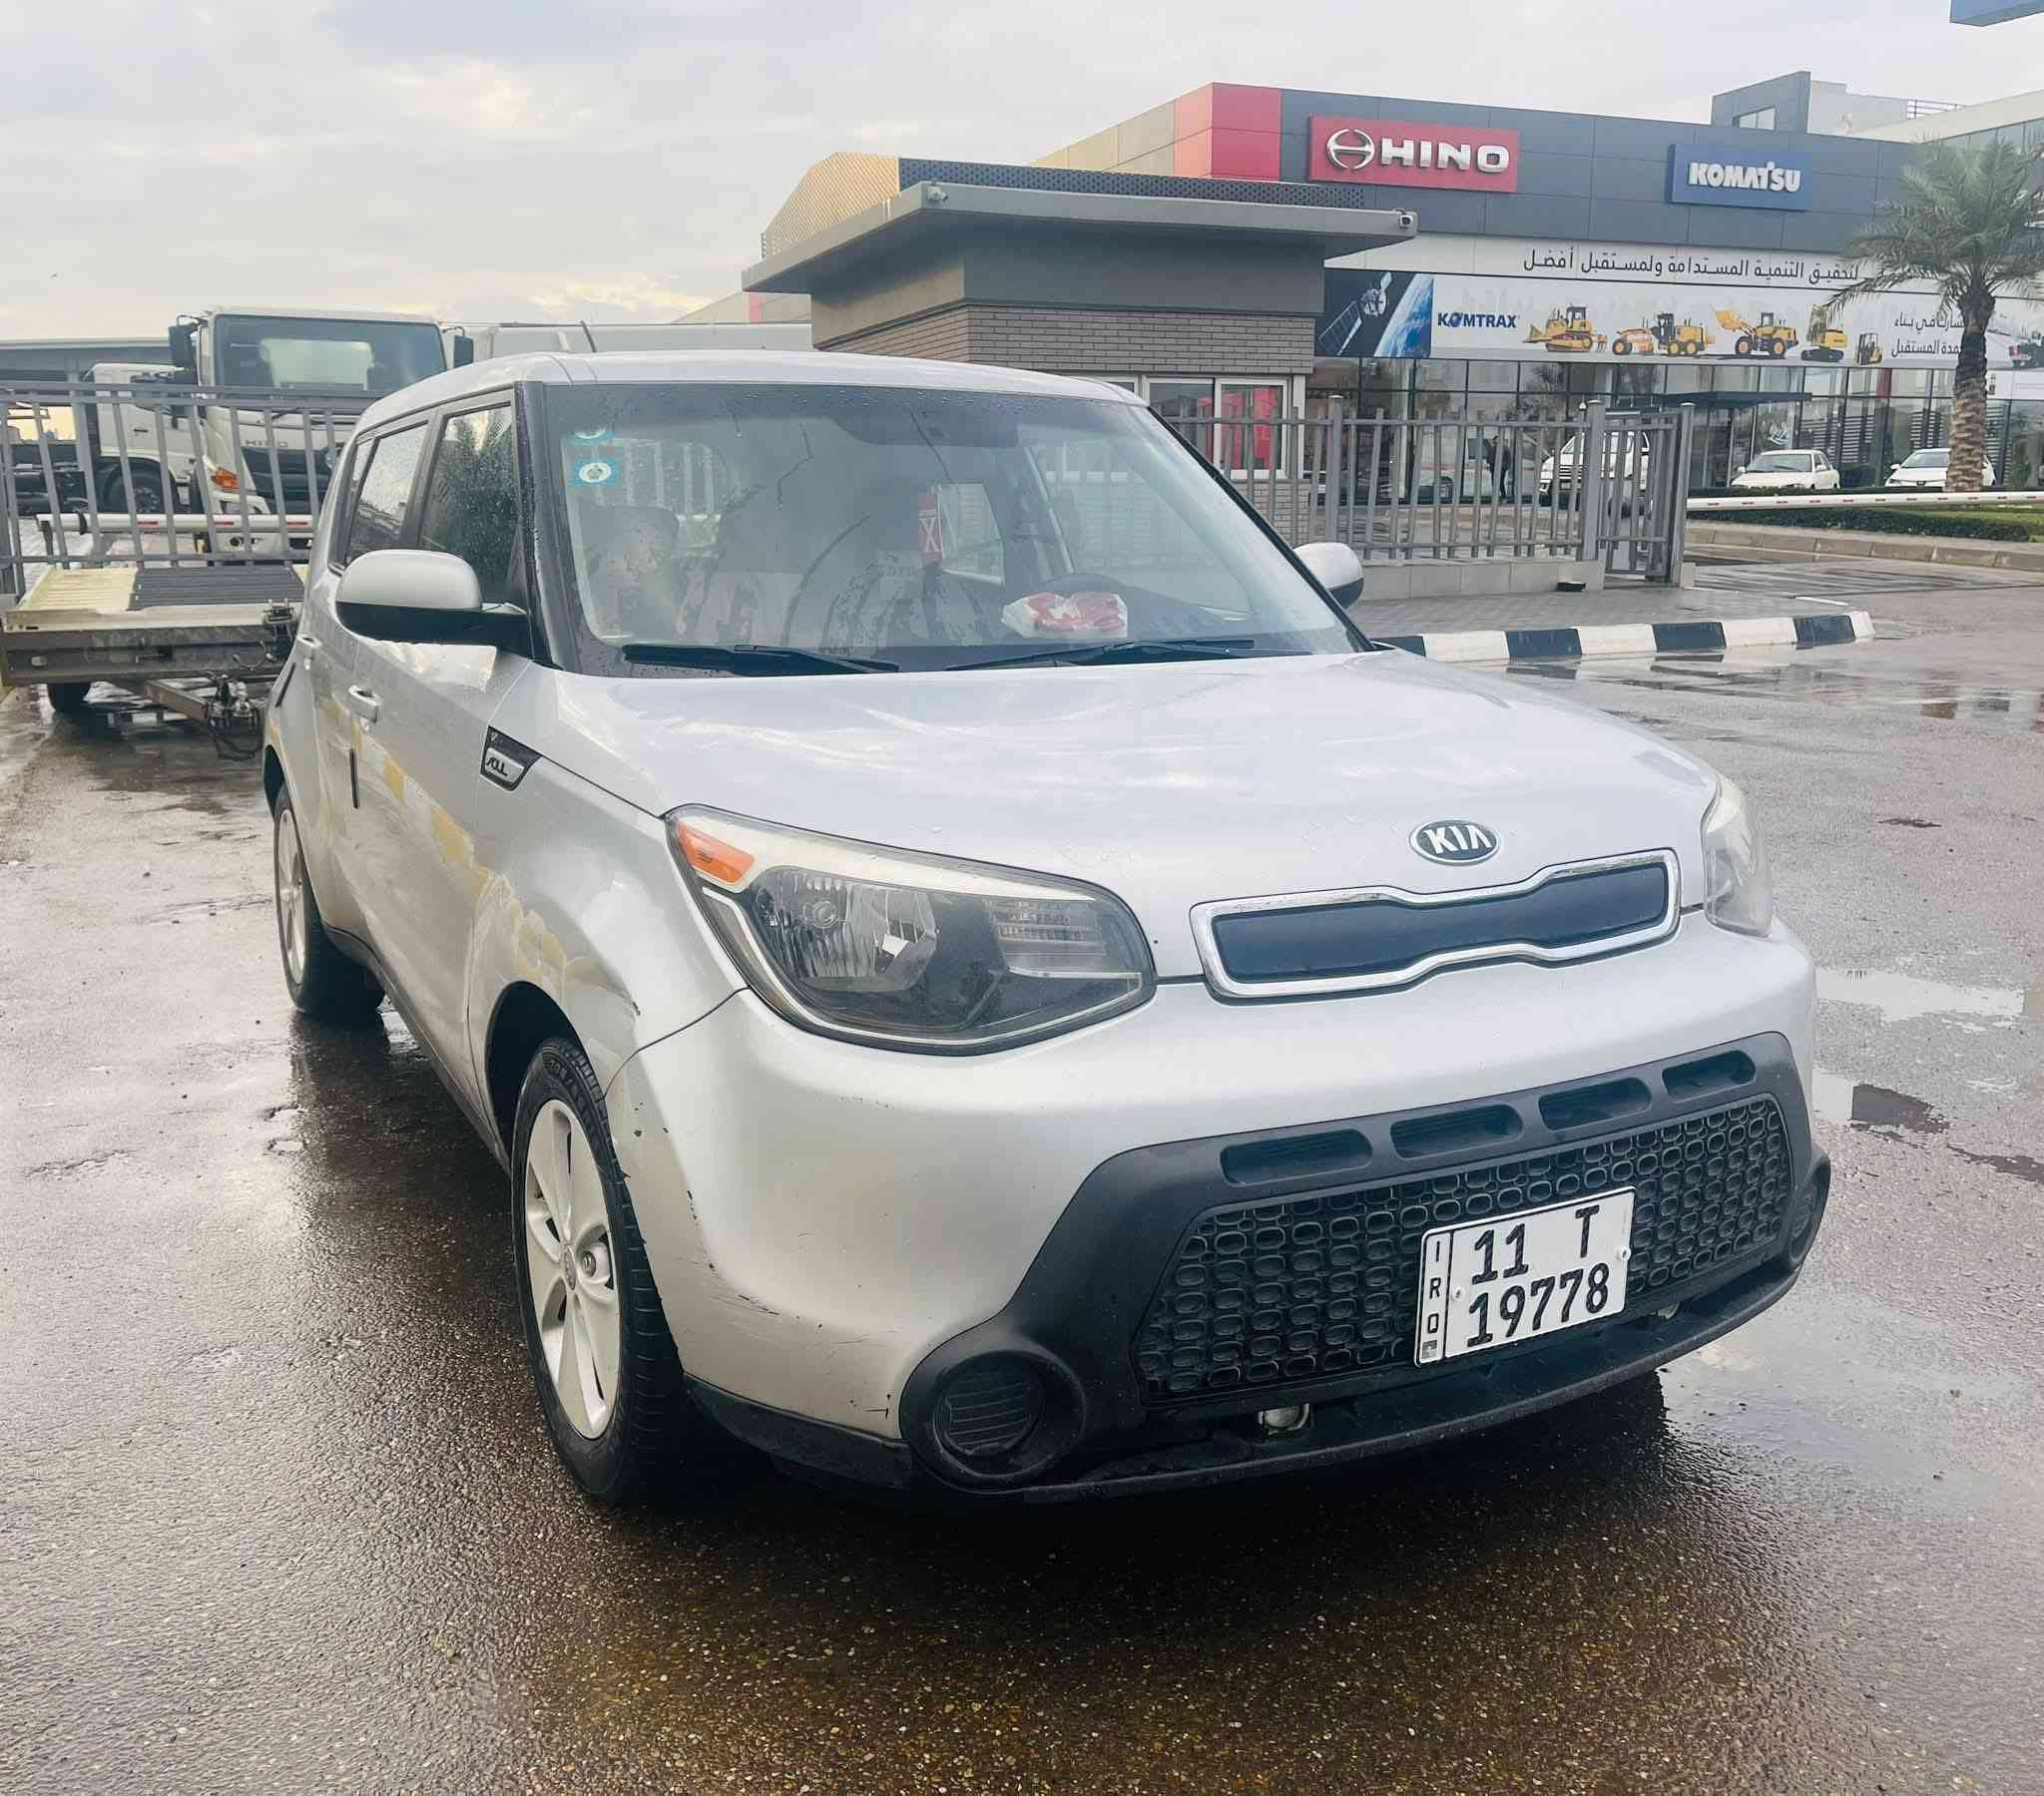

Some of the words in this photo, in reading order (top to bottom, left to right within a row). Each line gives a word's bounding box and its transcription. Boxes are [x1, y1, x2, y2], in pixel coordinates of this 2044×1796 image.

[1380, 137, 1510, 174] HINO
[1688, 161, 1801, 193] KOMATSU
[1523, 244, 1574, 271] أفضل
[1581, 250, 1663, 277] ولمستقبل
[1668, 254, 1750, 276] المستدامة
[1754, 259, 1804, 281] التنمية
[1437, 312, 1517, 327] KOMTRAX
[1423, 824, 1493, 854] KIA
[1471, 1222, 1529, 1285] 11
[1575, 1204, 1600, 1258] T
[1466, 1262, 1610, 1347] 19778
